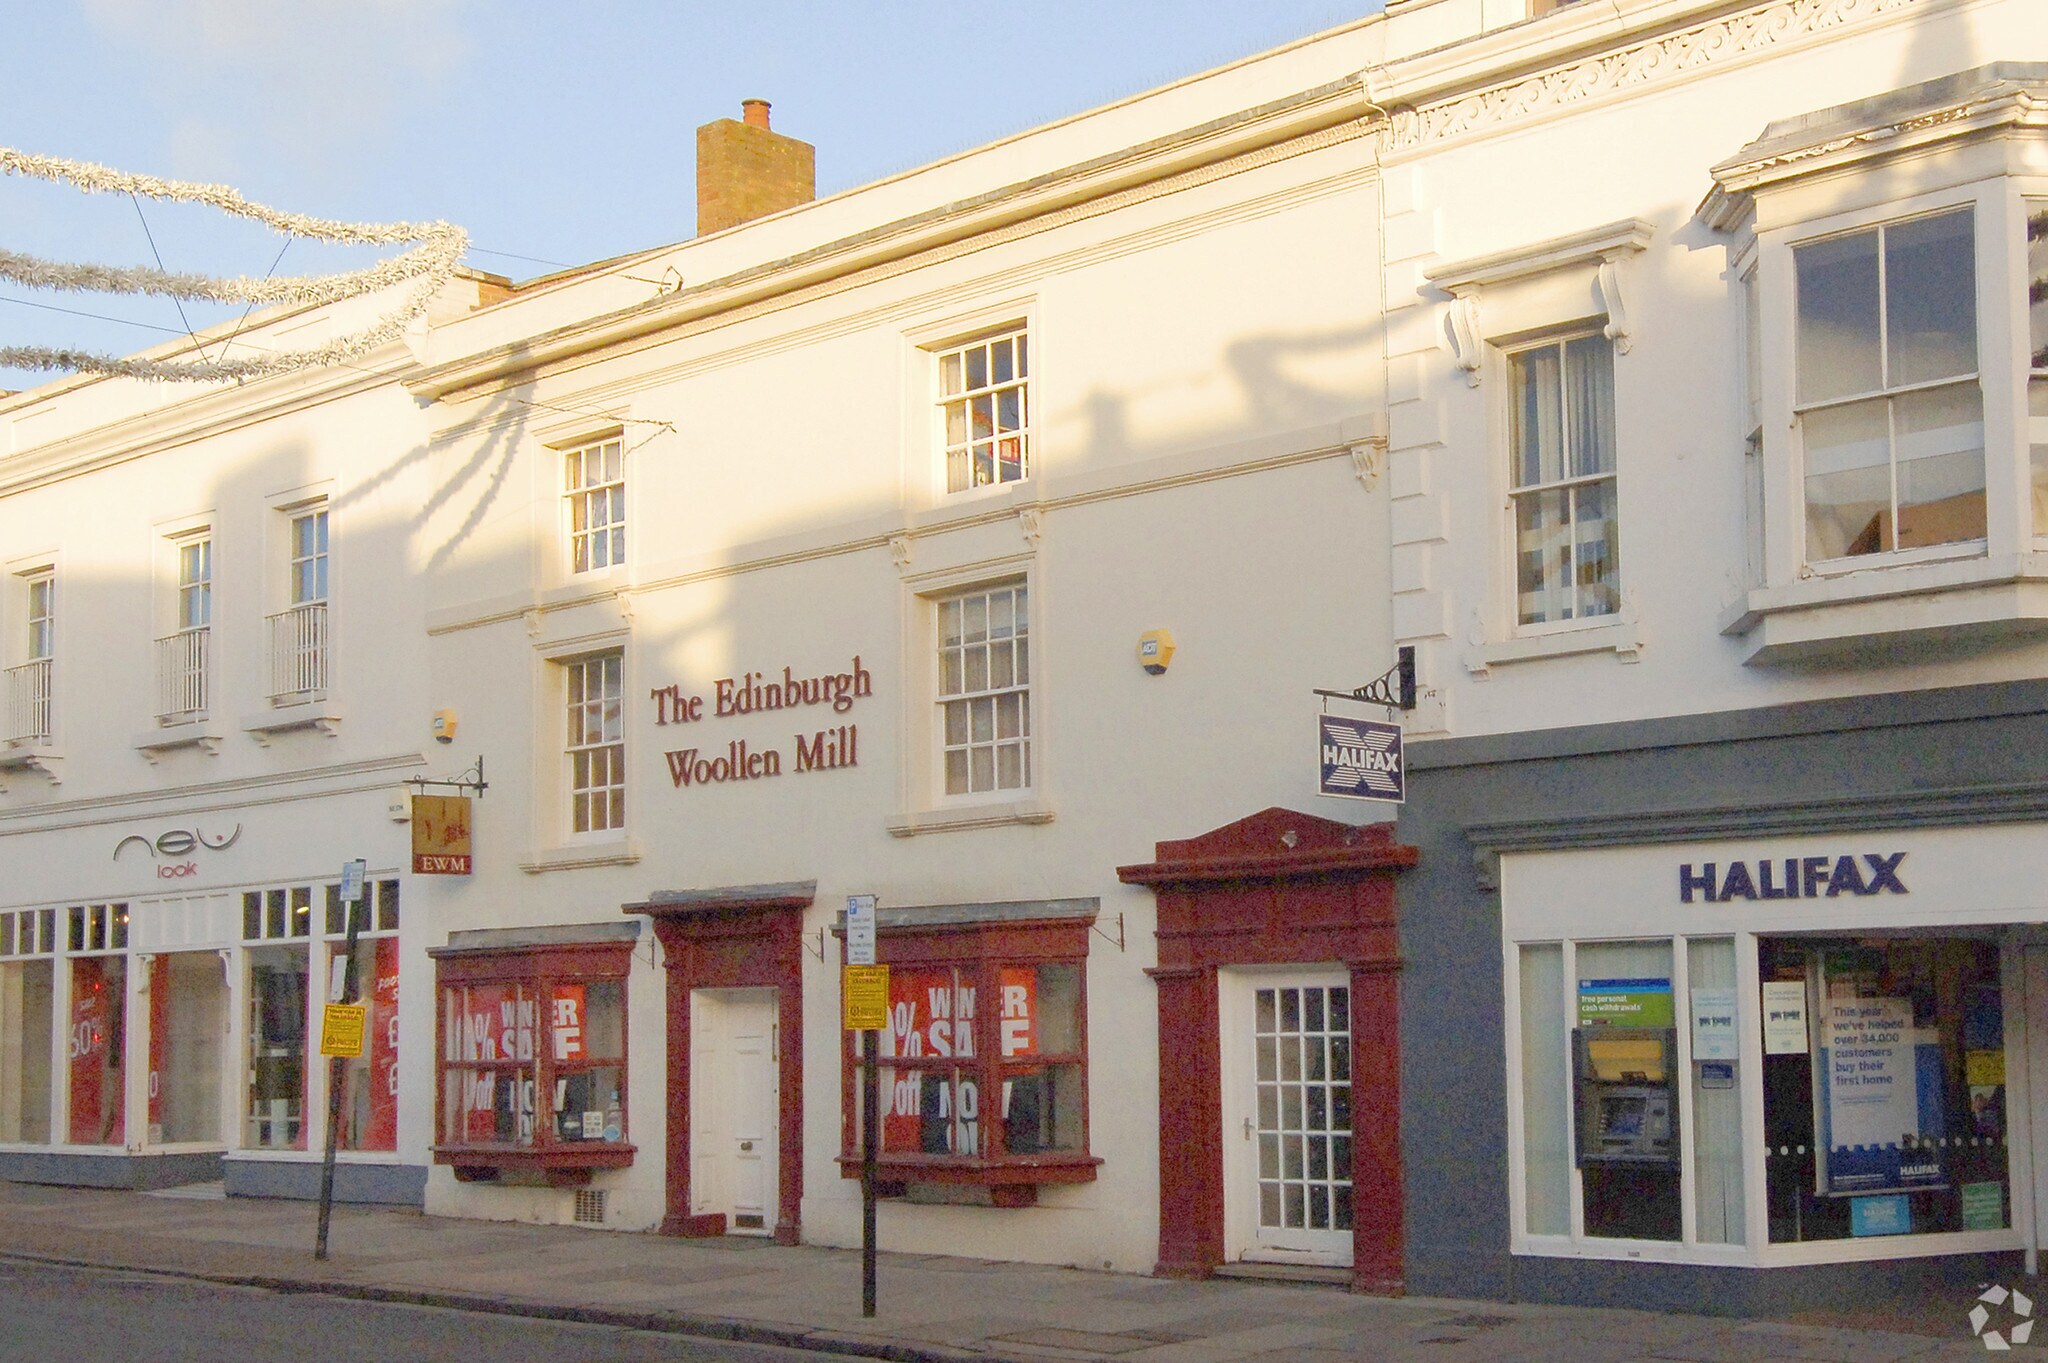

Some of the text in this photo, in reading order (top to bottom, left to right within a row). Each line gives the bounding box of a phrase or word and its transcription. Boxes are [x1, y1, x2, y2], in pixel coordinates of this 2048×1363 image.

[651, 655, 873, 726] The Edinburgh
[665, 724, 858, 788] Woollen Mill
[1323, 744, 1398, 772] HALIFAX
[157, 860, 198, 879] look
[422, 856, 465, 871] EWM
[1680, 851, 1910, 903] HALIFAX
[1597, 995, 1627, 1004] personal
[1582, 1004, 1598, 1012] cash
[1834, 1007, 1882, 1018] This year
[1834, 1019, 1904, 1031] we've helped
[1834, 1035, 1858, 1044] over
[1835, 1048, 1893, 1058] customers
[1835, 1060, 1884, 1073] buy their
[1836, 1074, 1893, 1086] first home
[1900, 1164, 1940, 1176] HALIFAX
